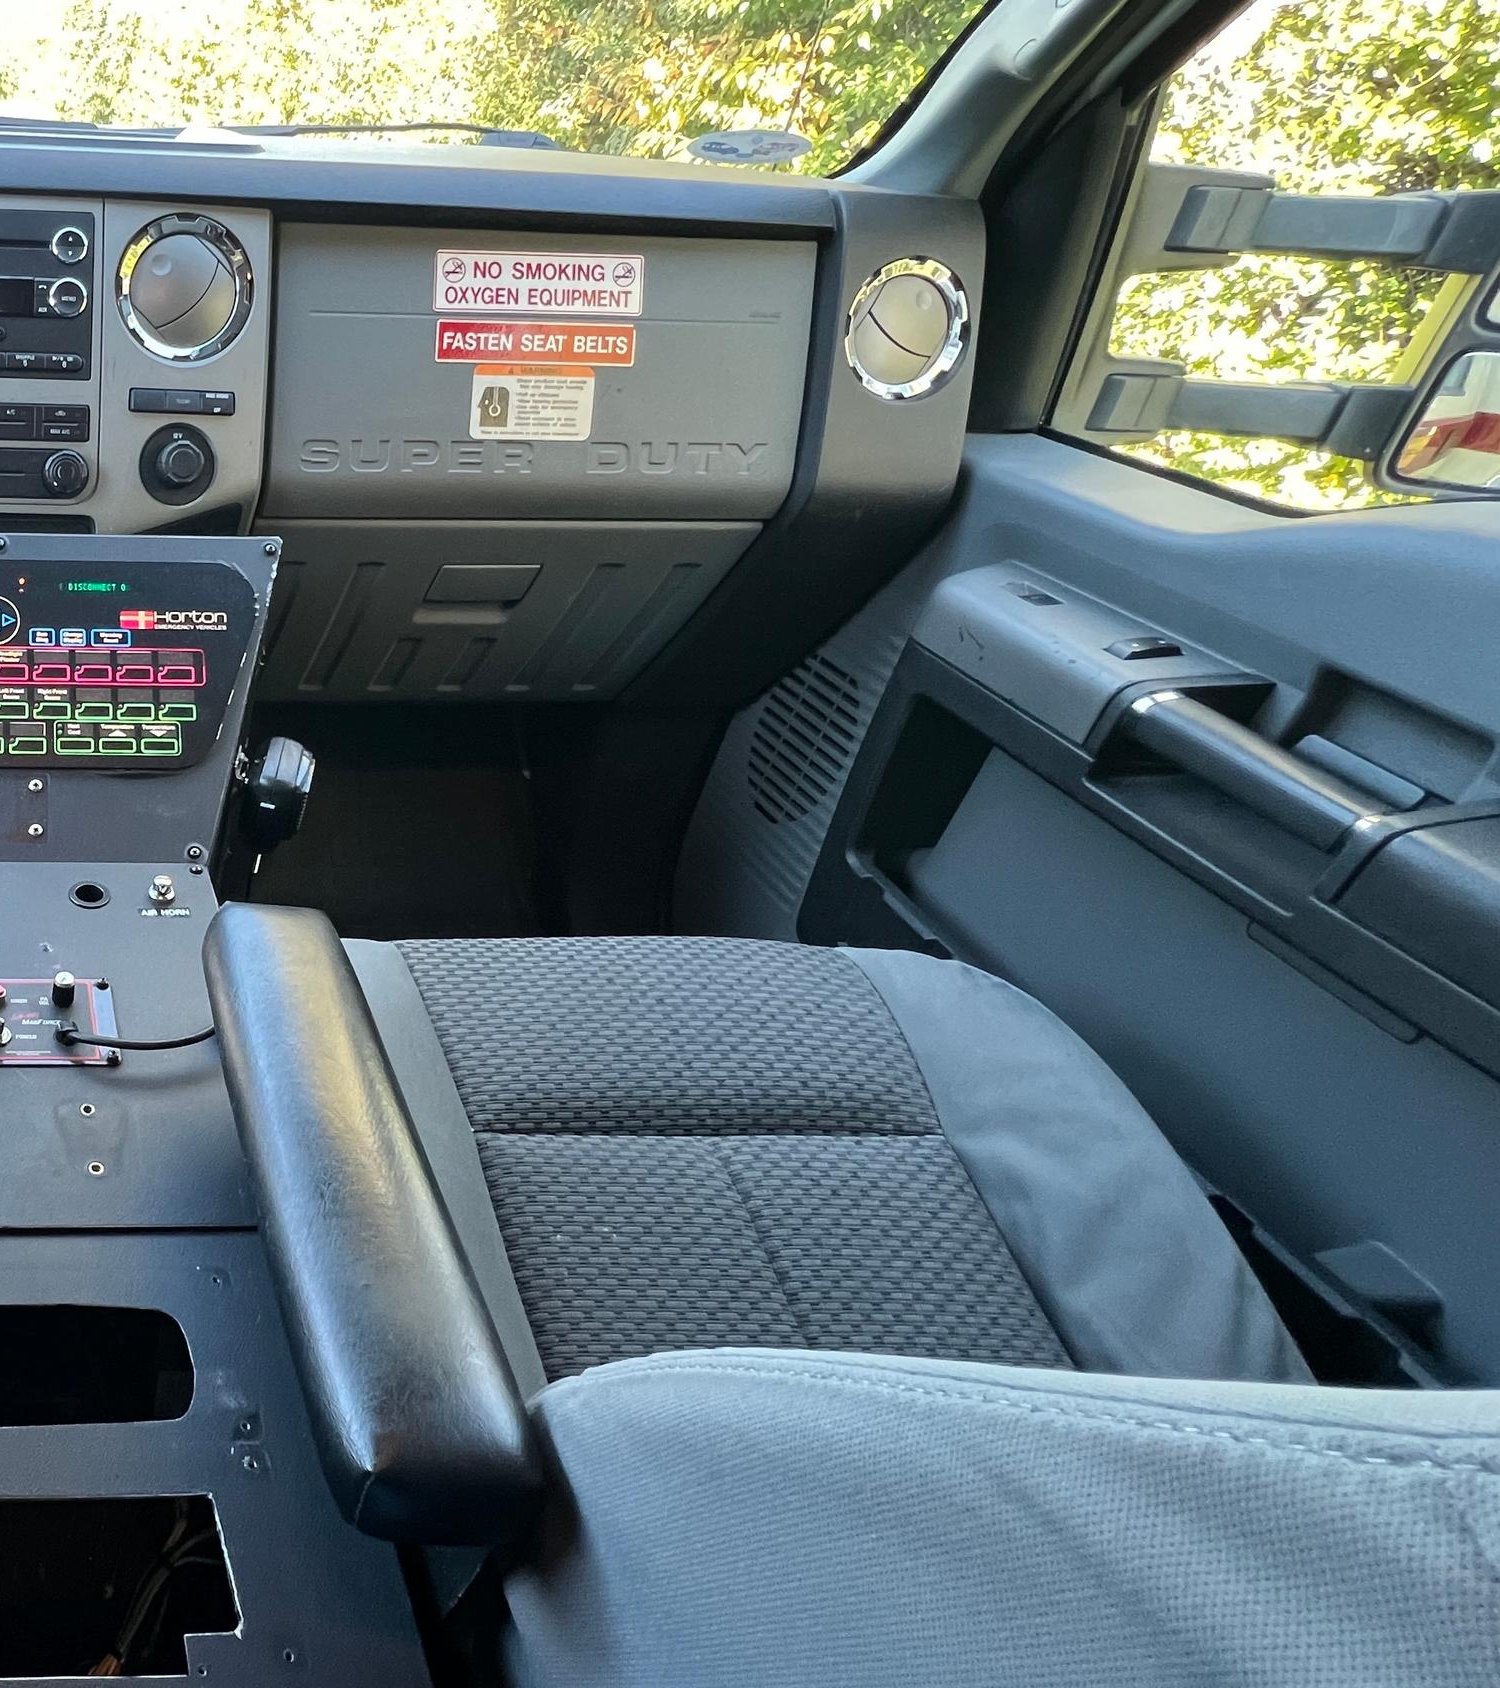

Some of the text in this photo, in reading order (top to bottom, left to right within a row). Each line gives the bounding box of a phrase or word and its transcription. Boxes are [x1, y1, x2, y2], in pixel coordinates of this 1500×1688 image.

[473, 261, 606, 282] NO SMOKING
[445, 286, 632, 308] OXYGEN EQUIPMENT
[442, 332, 628, 355] FASTEN SEAT BELTS
[300, 438, 769, 475] SUPER DUTY
[68, 583, 116, 591] DISCONNECT
[154, 610, 228, 624] Horton
